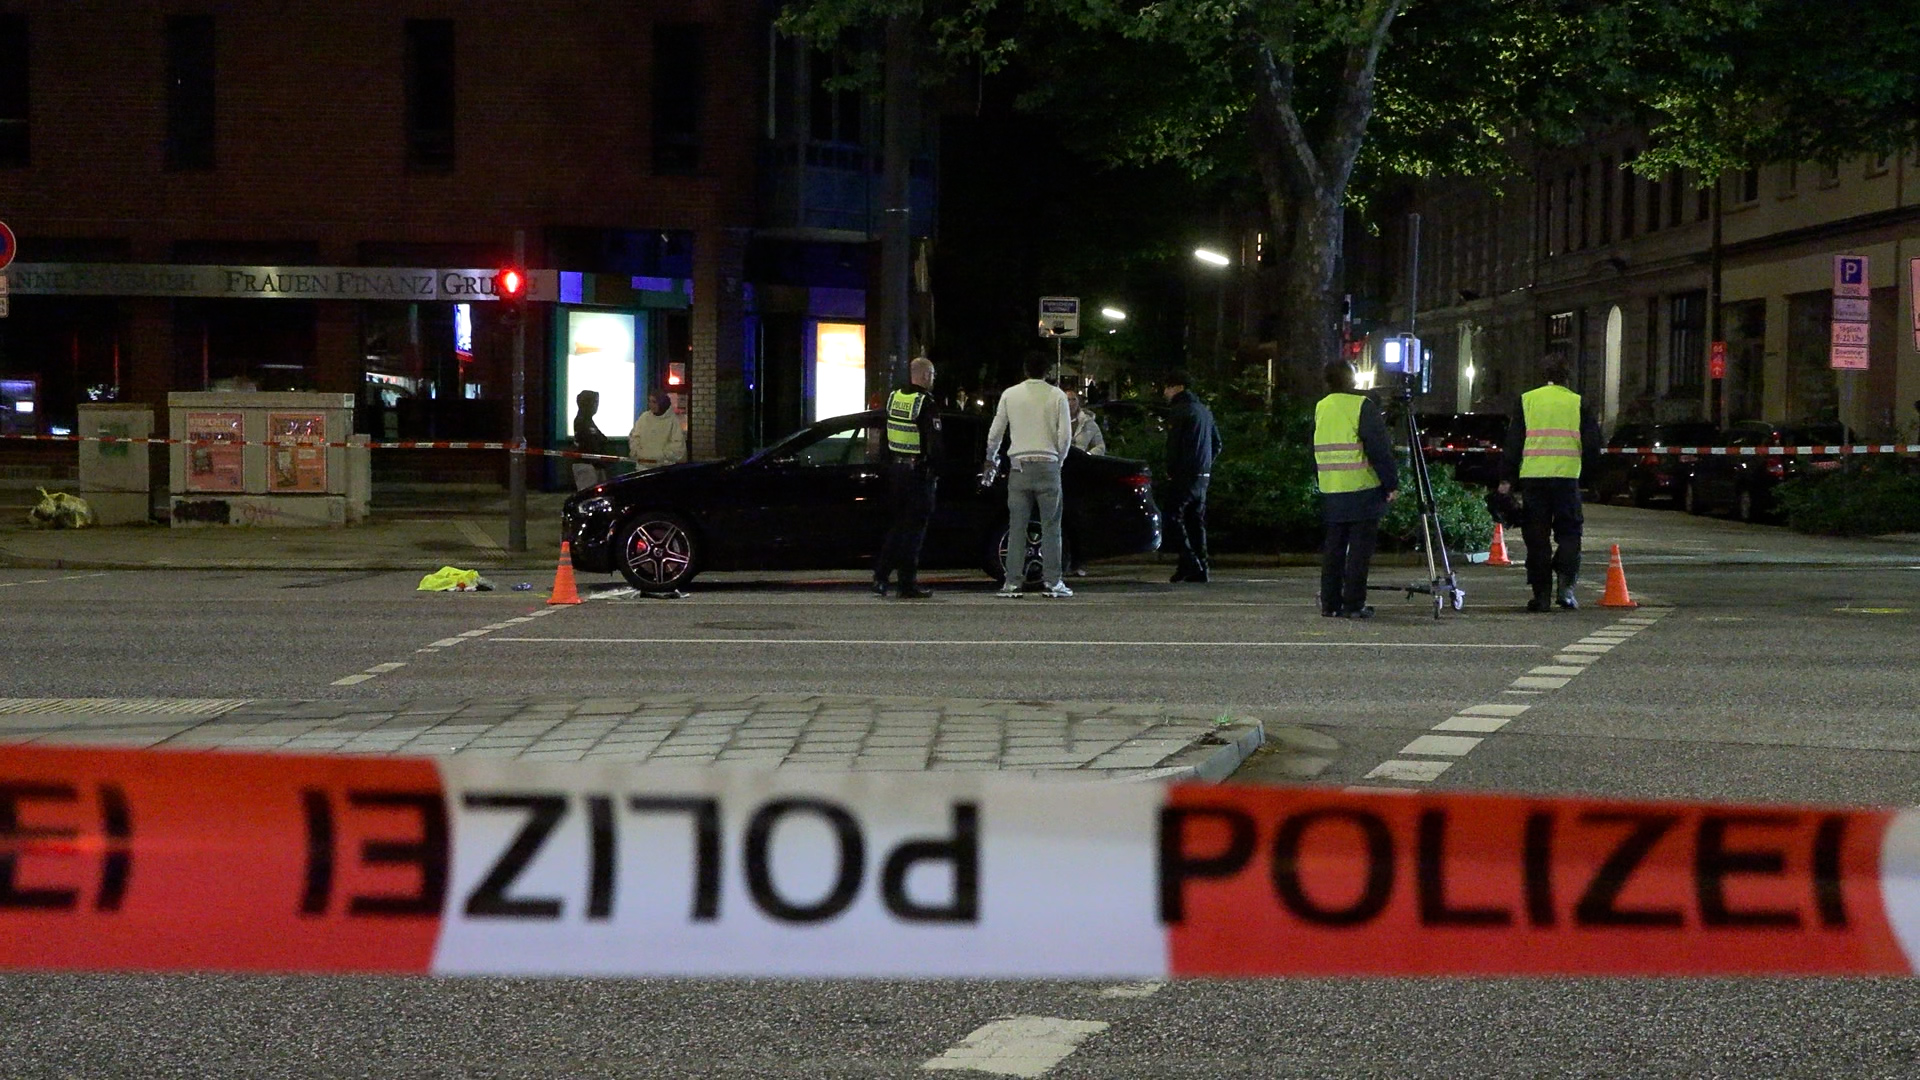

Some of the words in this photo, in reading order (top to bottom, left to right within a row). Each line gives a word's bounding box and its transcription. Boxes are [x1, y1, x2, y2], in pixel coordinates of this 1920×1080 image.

[223, 271, 329, 293] FRAUEN
[335, 272, 434, 295] FINANZ
[441, 272, 538, 296] GRUE
[1845, 262, 1858, 282] P
[892, 400, 912, 411] POLIZEI
[299, 787, 981, 925] POLIZEI
[1157, 804, 1848, 929] POLIZEI
